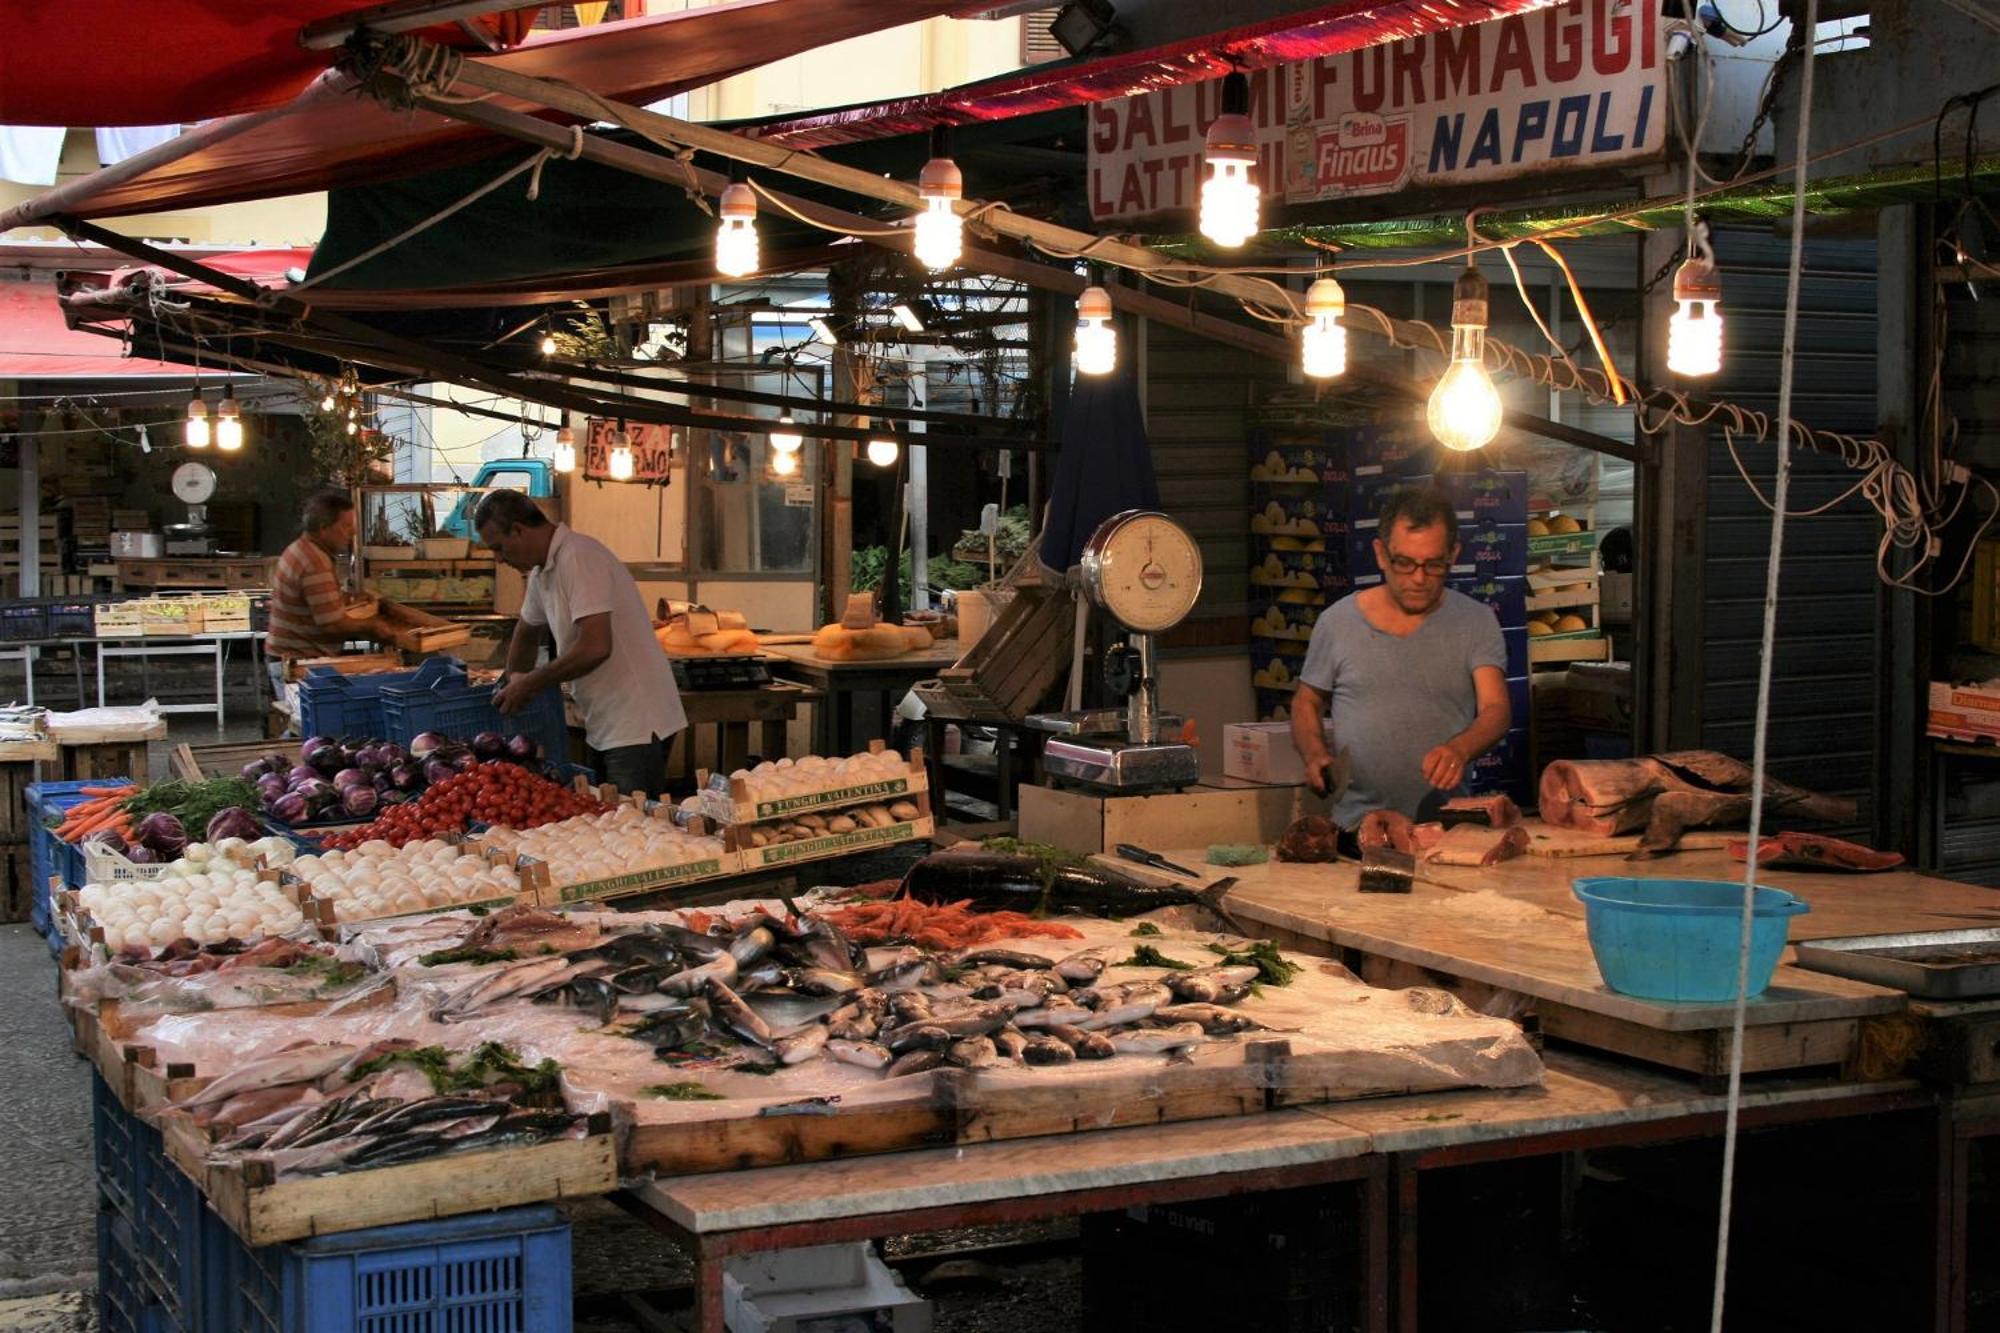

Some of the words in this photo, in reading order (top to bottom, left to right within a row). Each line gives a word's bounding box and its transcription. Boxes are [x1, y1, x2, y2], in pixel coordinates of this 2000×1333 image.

[1313, 0, 1657, 120] FORMAGGI
[1351, 119, 1383, 138] Brina
[1428, 85, 1655, 174] NAPOLI
[1317, 141, 1398, 179] Findus
[826, 783, 890, 802] VALENTINA
